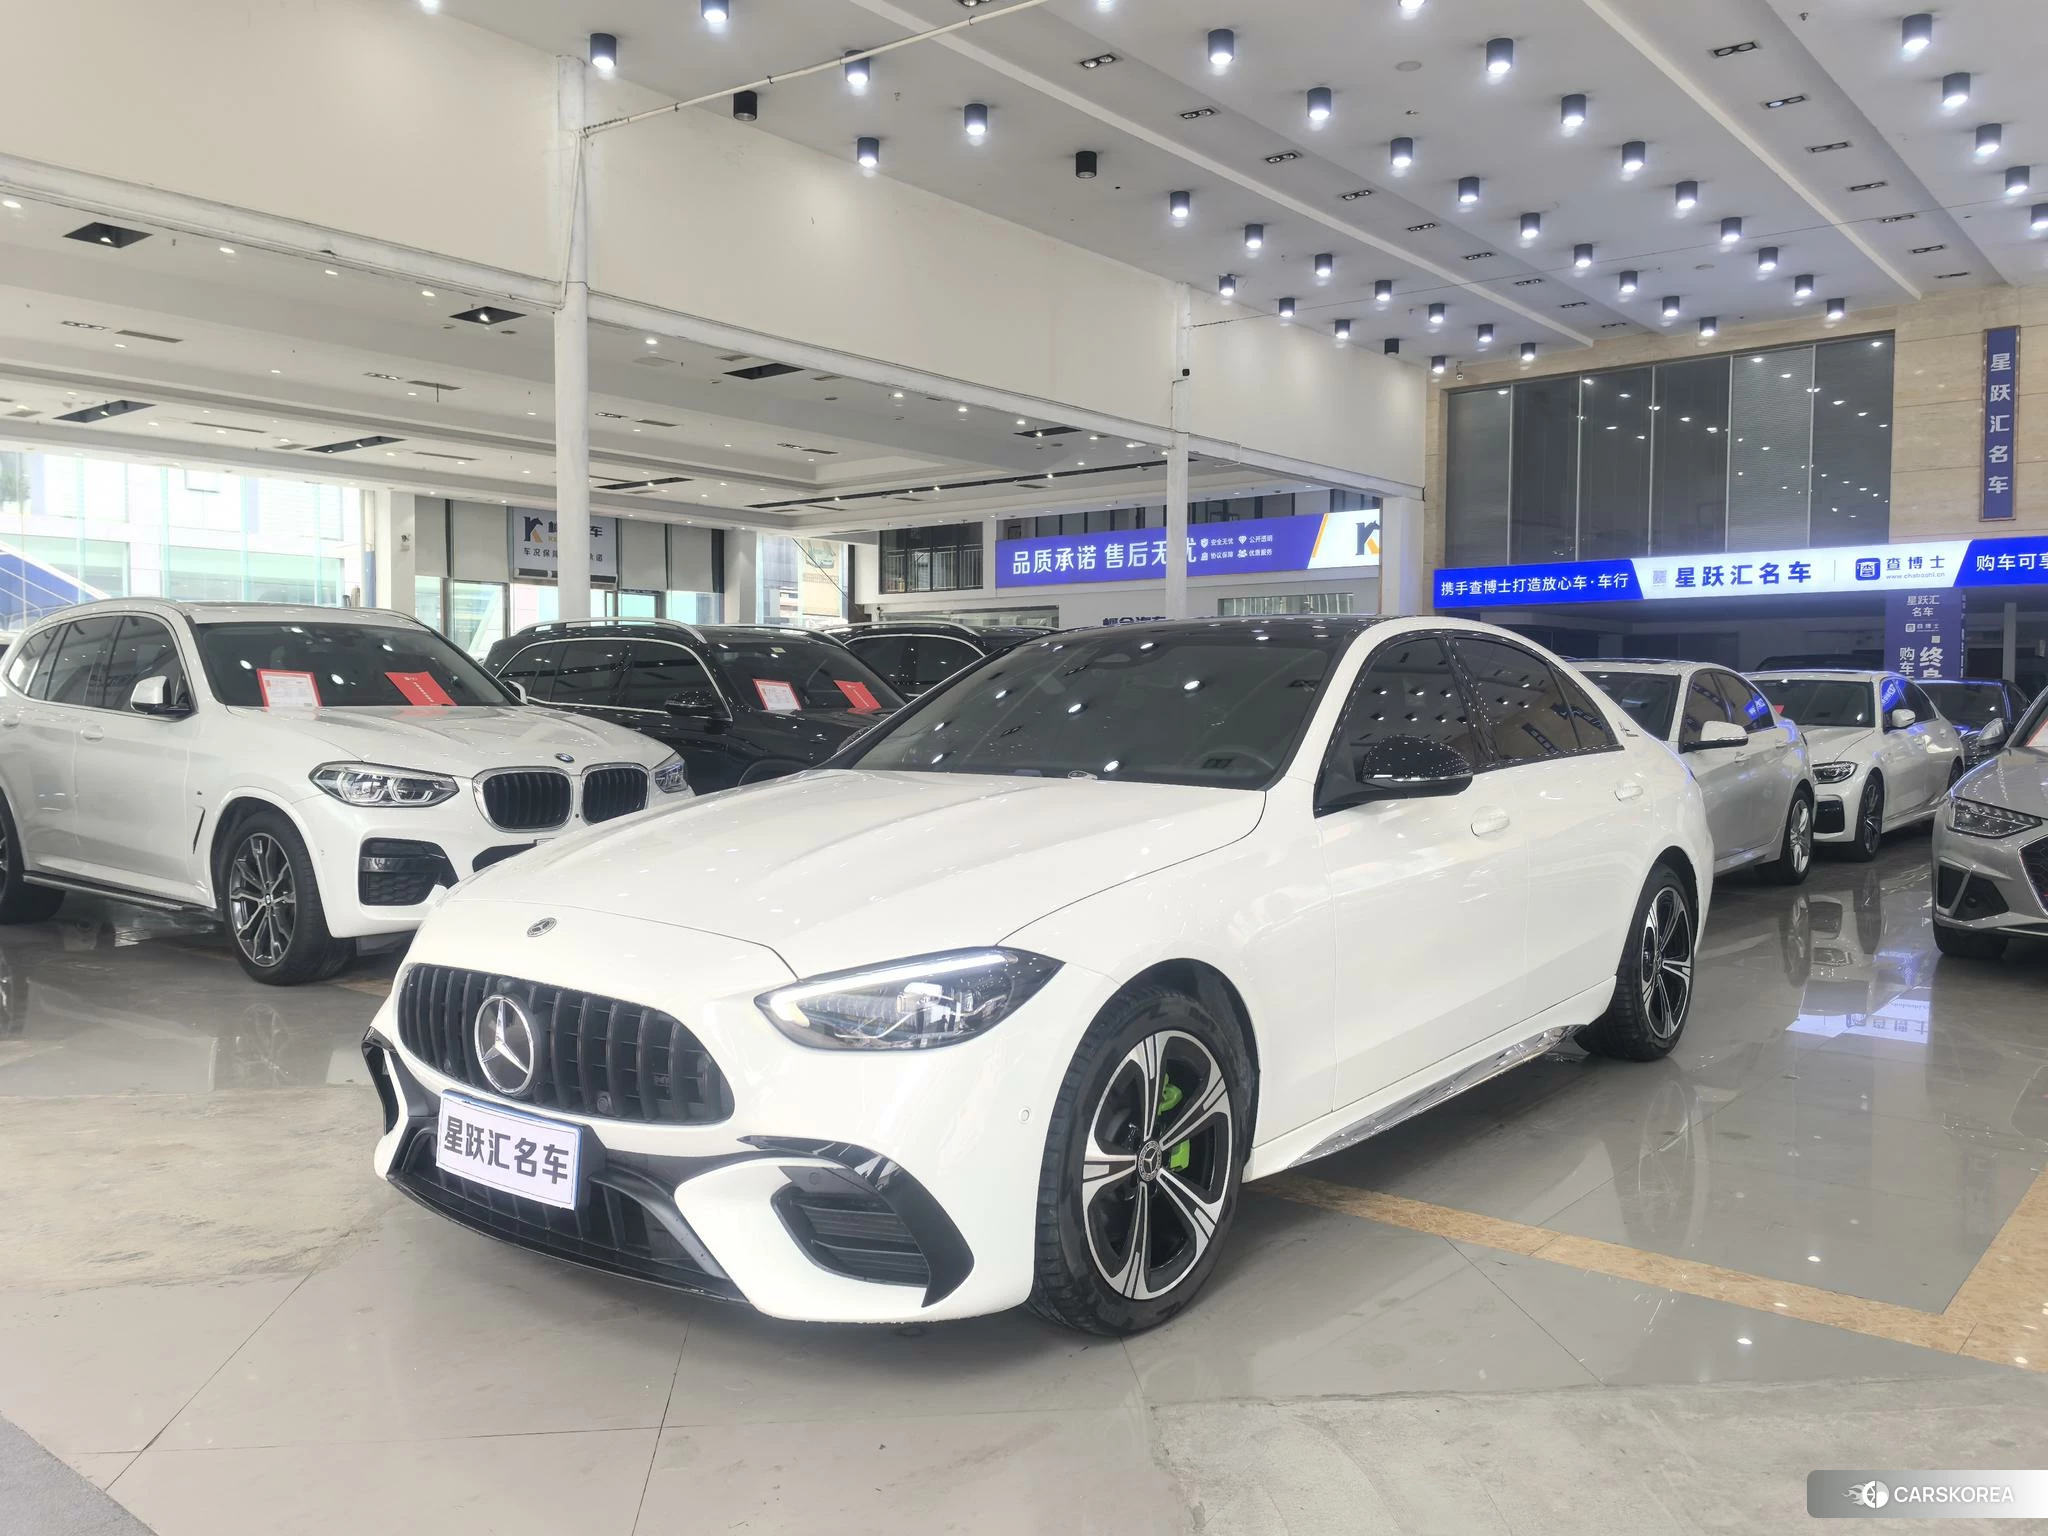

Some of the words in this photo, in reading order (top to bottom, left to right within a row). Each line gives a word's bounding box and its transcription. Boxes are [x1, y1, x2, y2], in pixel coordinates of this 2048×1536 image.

[1988, 353, 2011, 494] 星跃汇名车
[1013, 545, 1096, 575] 品质承诺
[1675, 560, 1811, 588] 星跃汇名车
[1886, 555, 1945, 571] 查博士
[1441, 573, 1629, 595] 携手查博士打造放心车·车行
[1907, 594, 1940, 606] 星跃汇
[1912, 606, 1934, 617] 名车
[1899, 646, 1915, 679] 购车
[444, 1115, 569, 1185] 星跃汇名车
